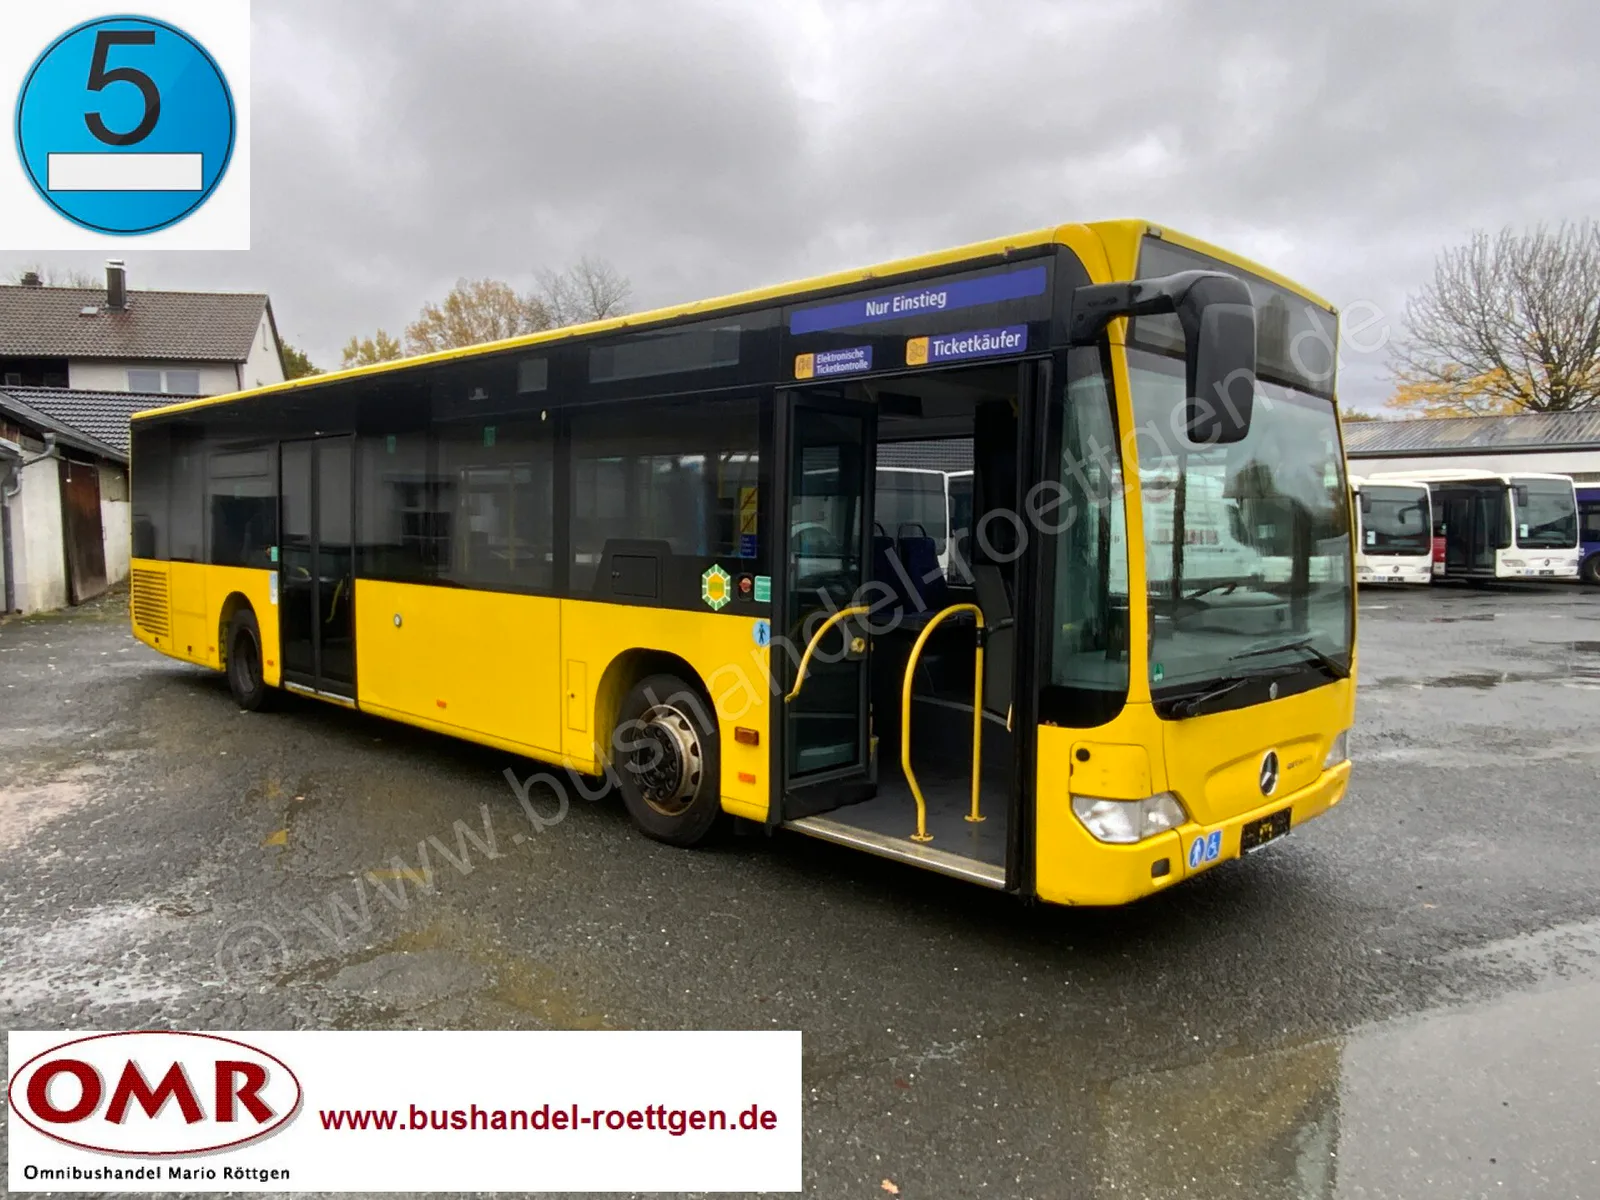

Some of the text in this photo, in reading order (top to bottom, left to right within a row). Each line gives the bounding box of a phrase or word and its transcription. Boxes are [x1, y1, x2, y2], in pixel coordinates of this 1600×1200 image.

[866, 291, 947, 316] Nur Einstieg
[933, 330, 1021, 356] Ticketkäufer
[816, 348, 864, 364] Elektronische
[816, 359, 869, 374] Ticketkontrolle
